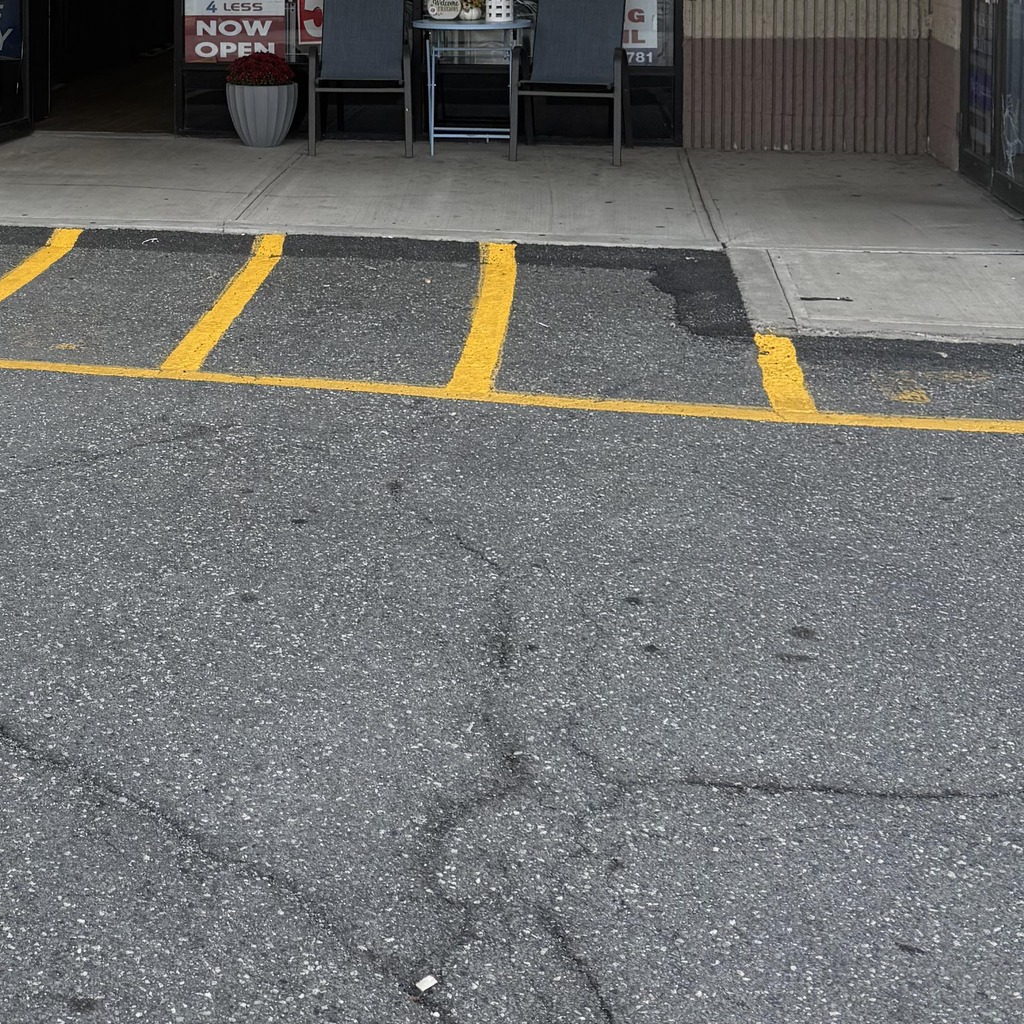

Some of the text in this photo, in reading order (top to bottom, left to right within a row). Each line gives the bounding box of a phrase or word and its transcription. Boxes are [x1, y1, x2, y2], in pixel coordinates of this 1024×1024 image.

[206, 1, 263, 13] 4 LESS
[196, 20, 272, 36] NOW
